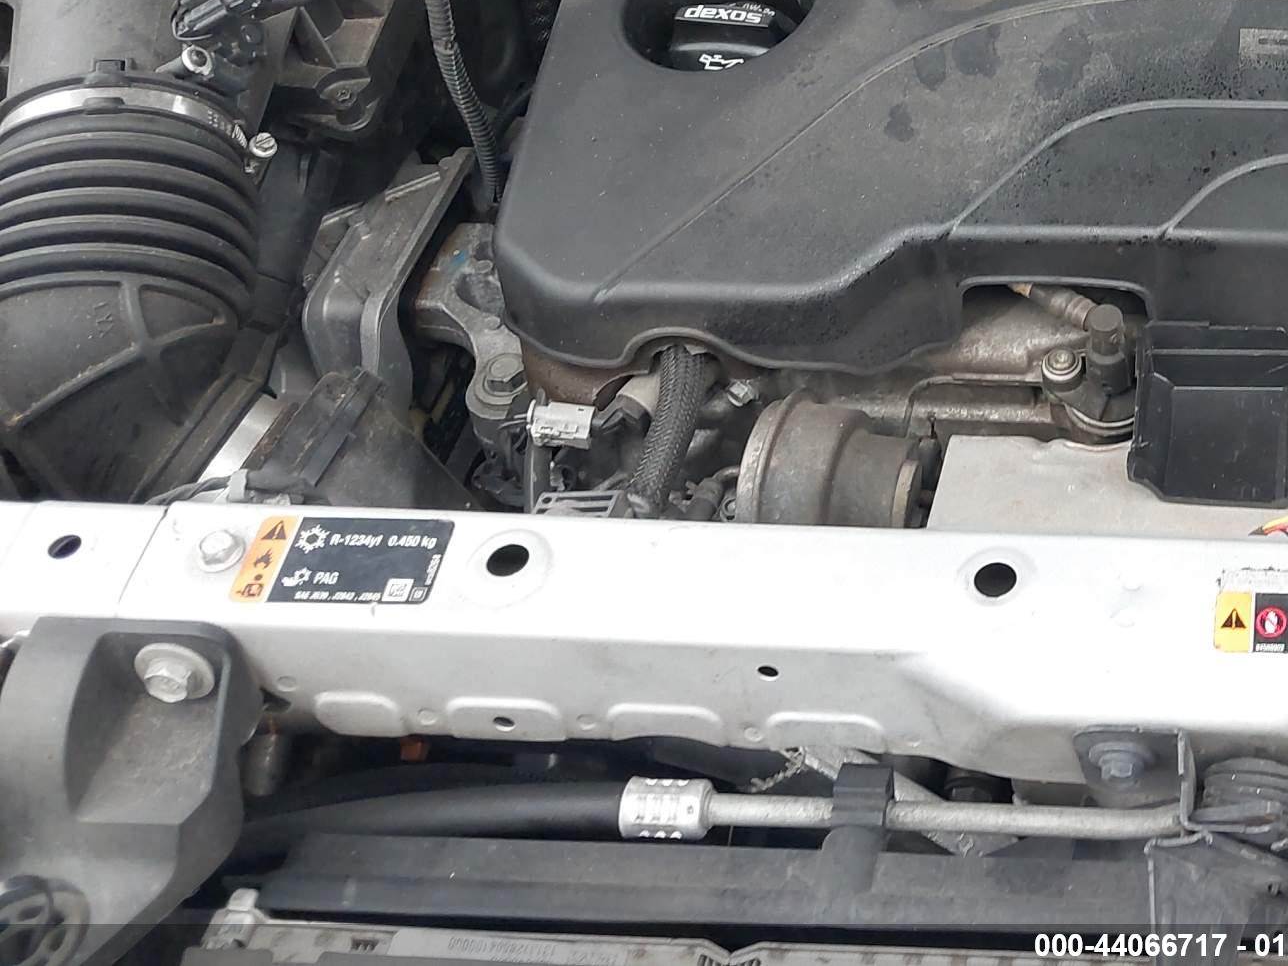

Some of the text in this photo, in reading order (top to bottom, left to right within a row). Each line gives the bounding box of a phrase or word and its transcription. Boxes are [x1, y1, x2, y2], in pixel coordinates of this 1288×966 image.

[684, 5, 763, 24] dexos
[420, 535, 438, 550] kg
[312, 571, 339, 585] PAG
